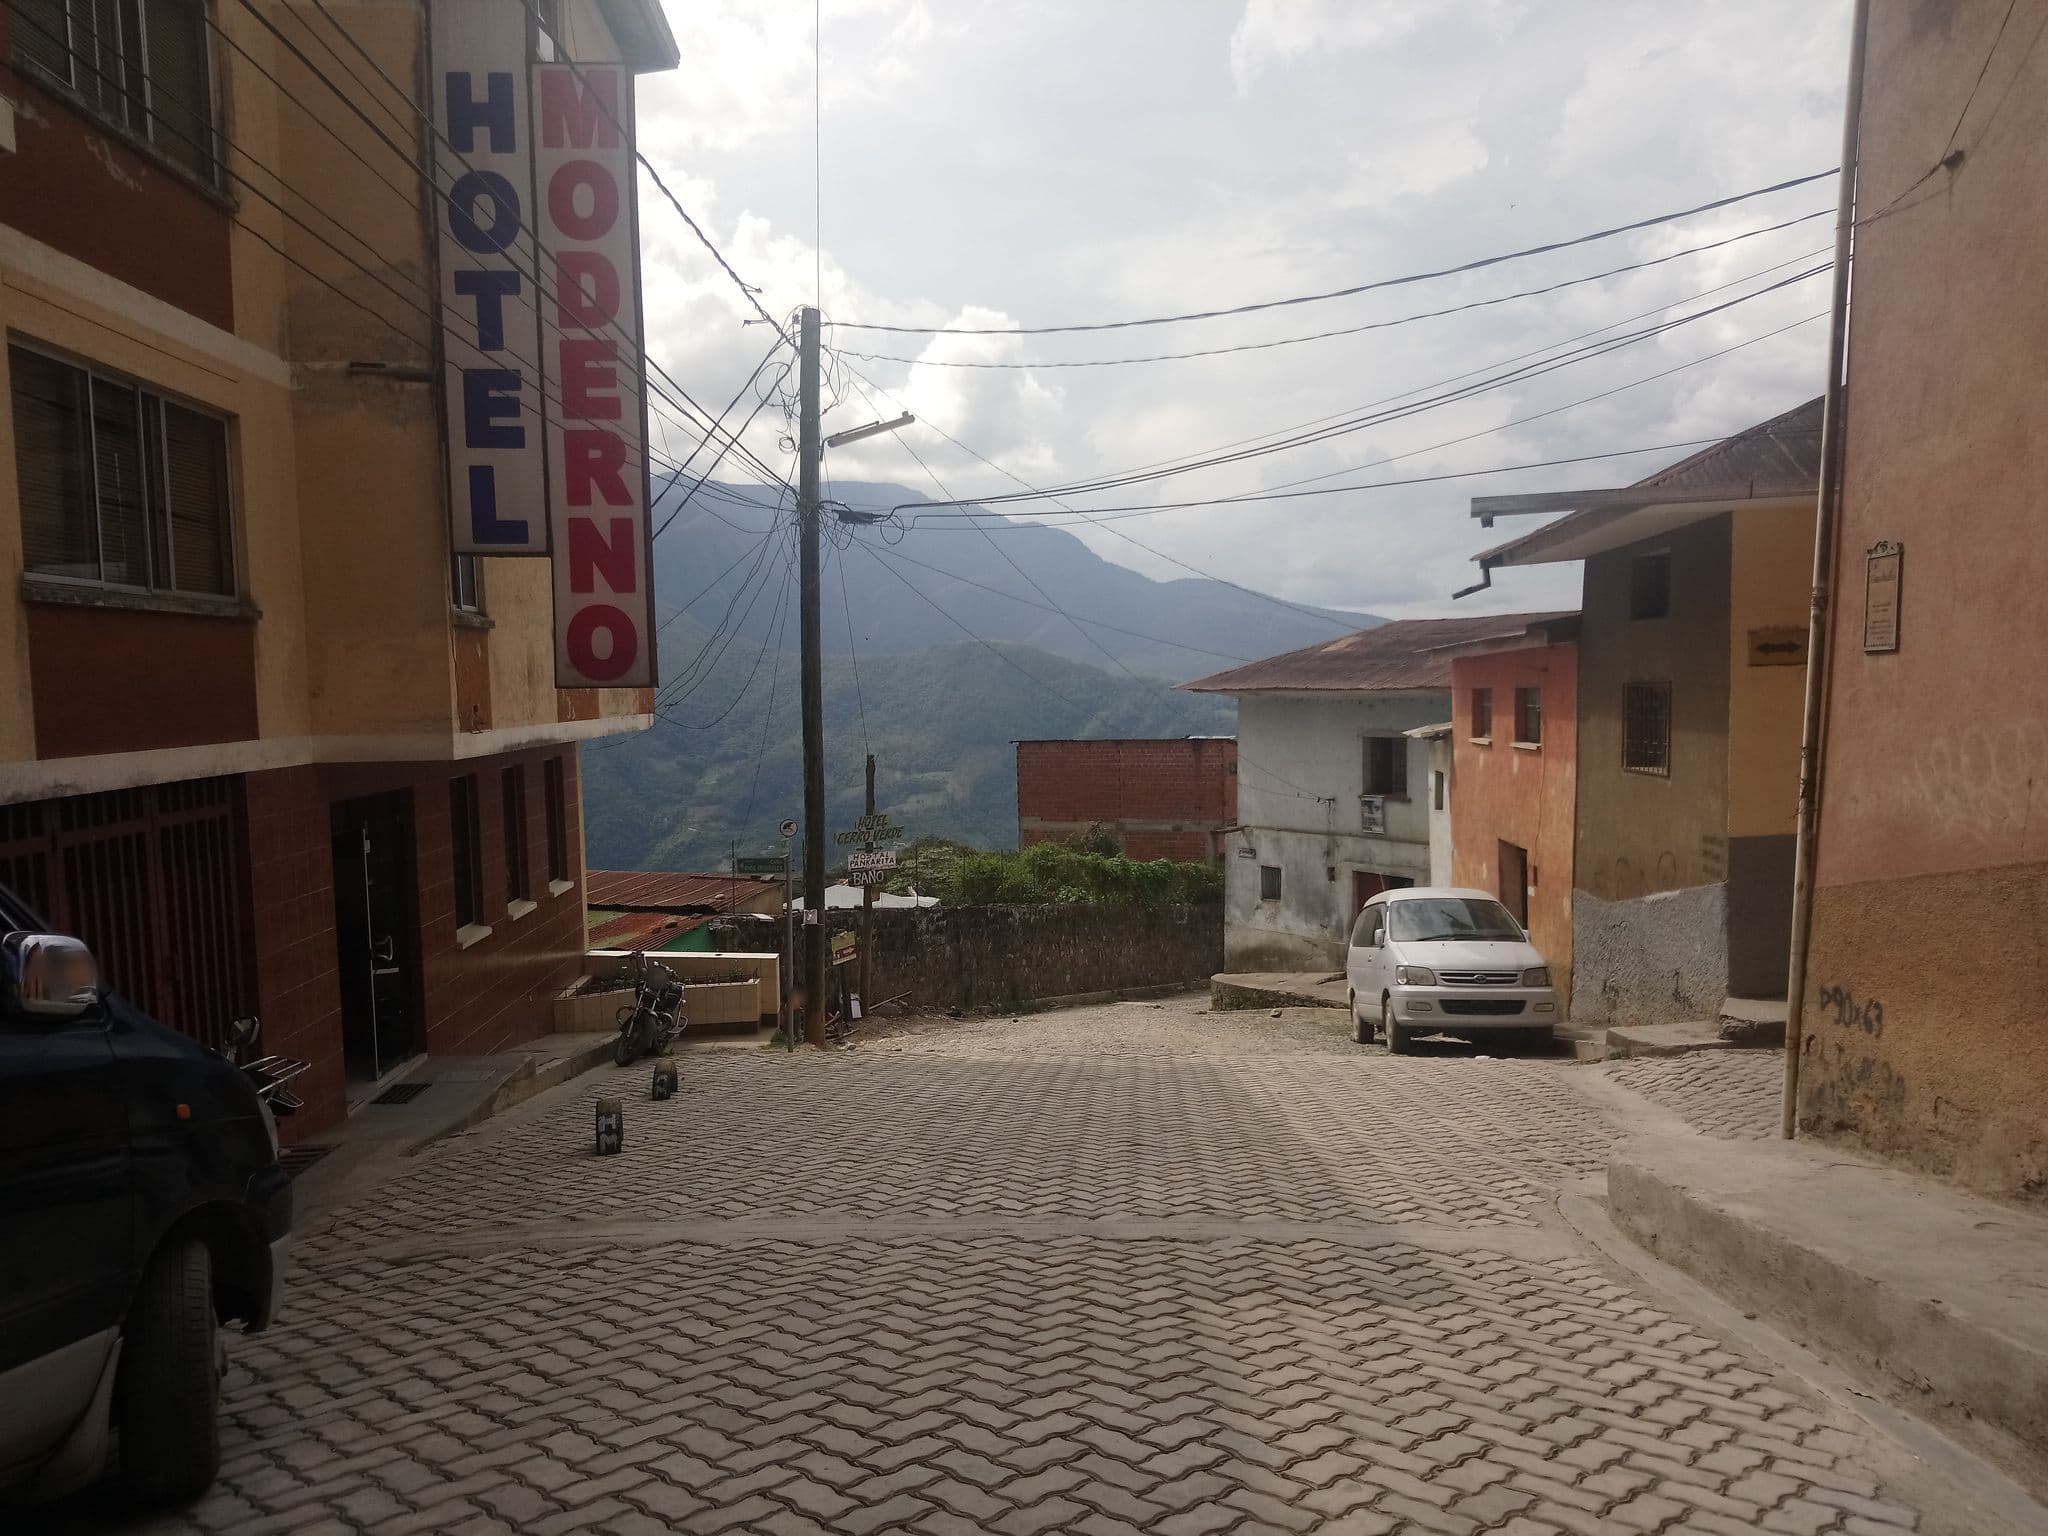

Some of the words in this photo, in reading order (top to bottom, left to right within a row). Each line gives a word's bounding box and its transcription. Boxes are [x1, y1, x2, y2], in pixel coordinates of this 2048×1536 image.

[446, 71, 529, 545] HOTEL
[540, 69, 638, 681] MODERNO
[858, 815, 888, 829] HOTEL
[837, 831, 871, 845] CERRO
[850, 857, 895, 867] PANKARITA
